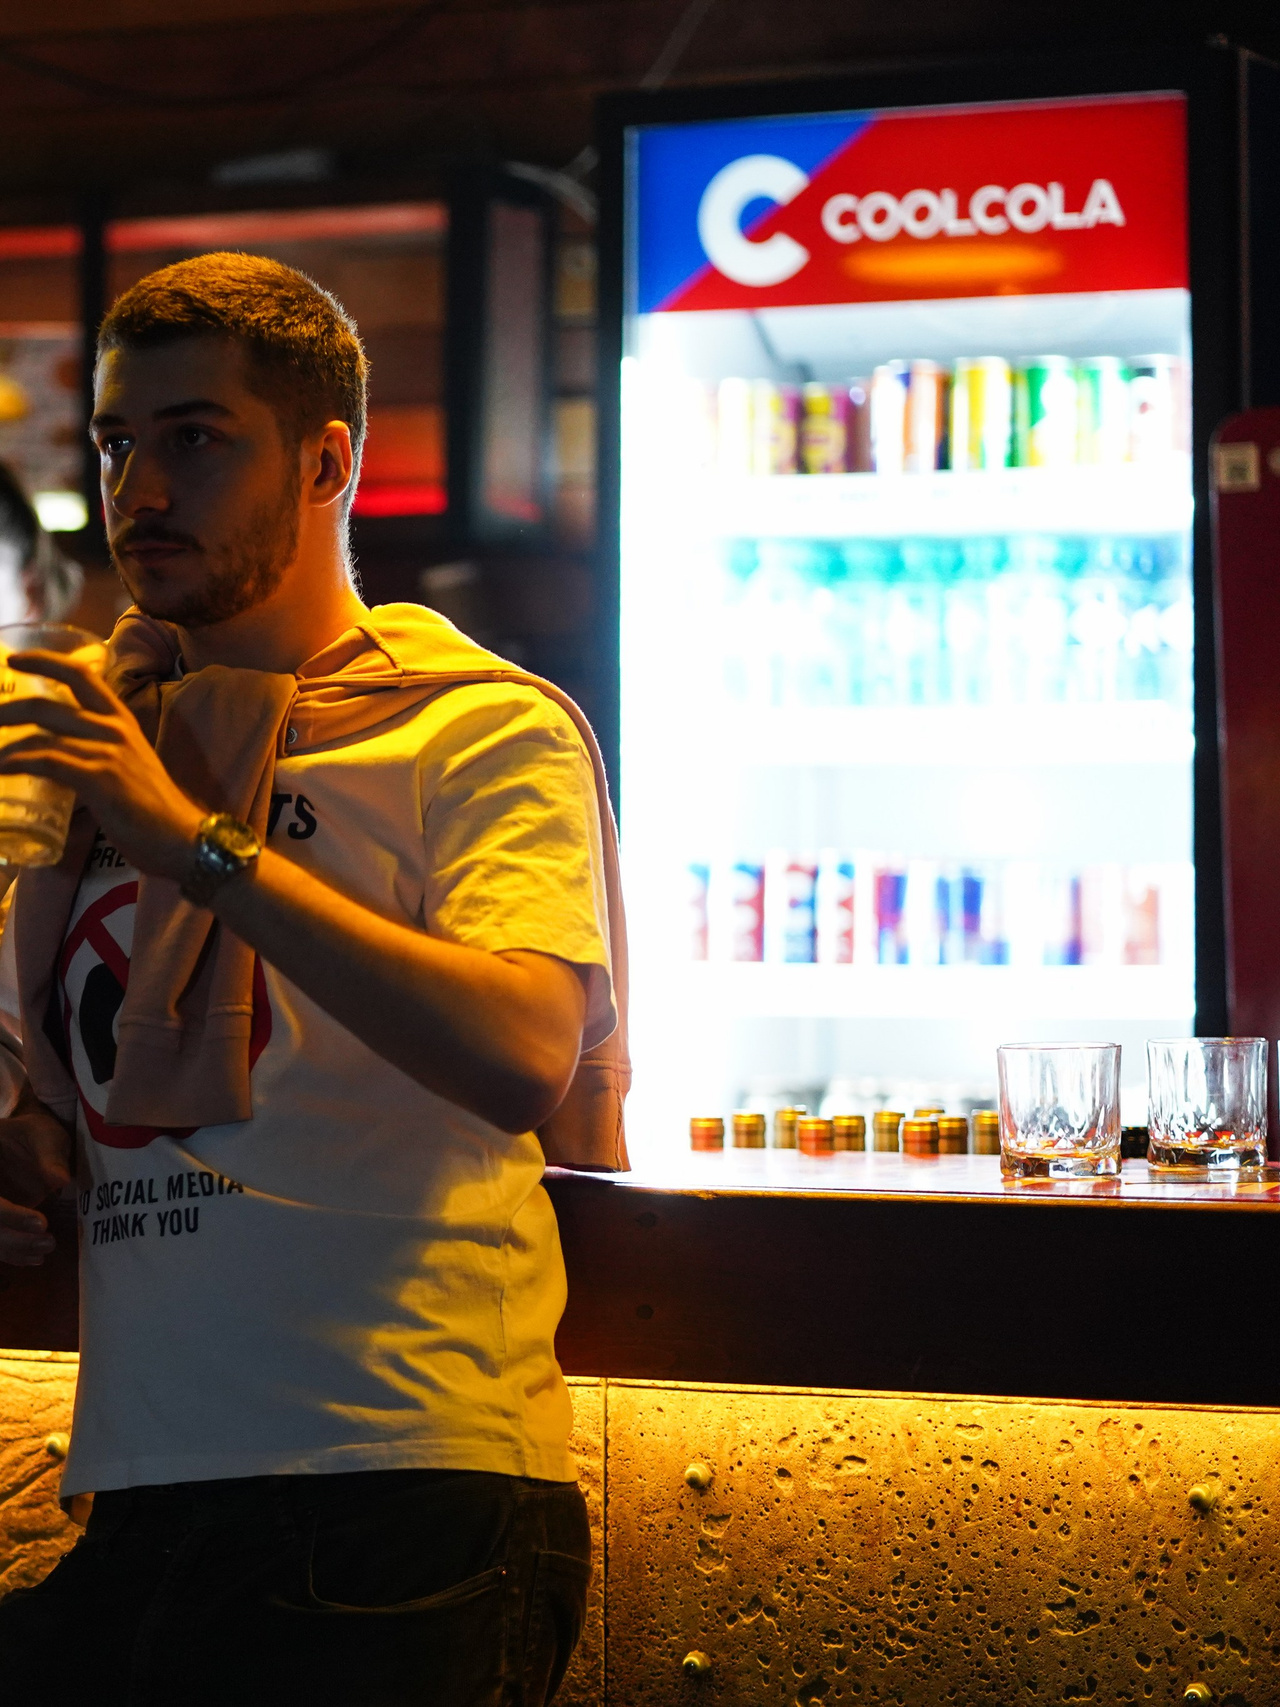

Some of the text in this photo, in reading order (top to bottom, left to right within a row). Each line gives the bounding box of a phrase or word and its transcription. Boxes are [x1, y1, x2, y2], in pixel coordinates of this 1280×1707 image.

[697, 154, 1127, 288] C COOLCOLA
[97, 1178, 159, 1212] SOCIAL
[167, 1171, 244, 1201] MEDIA
[93, 1206, 199, 1245] THANK YOU
